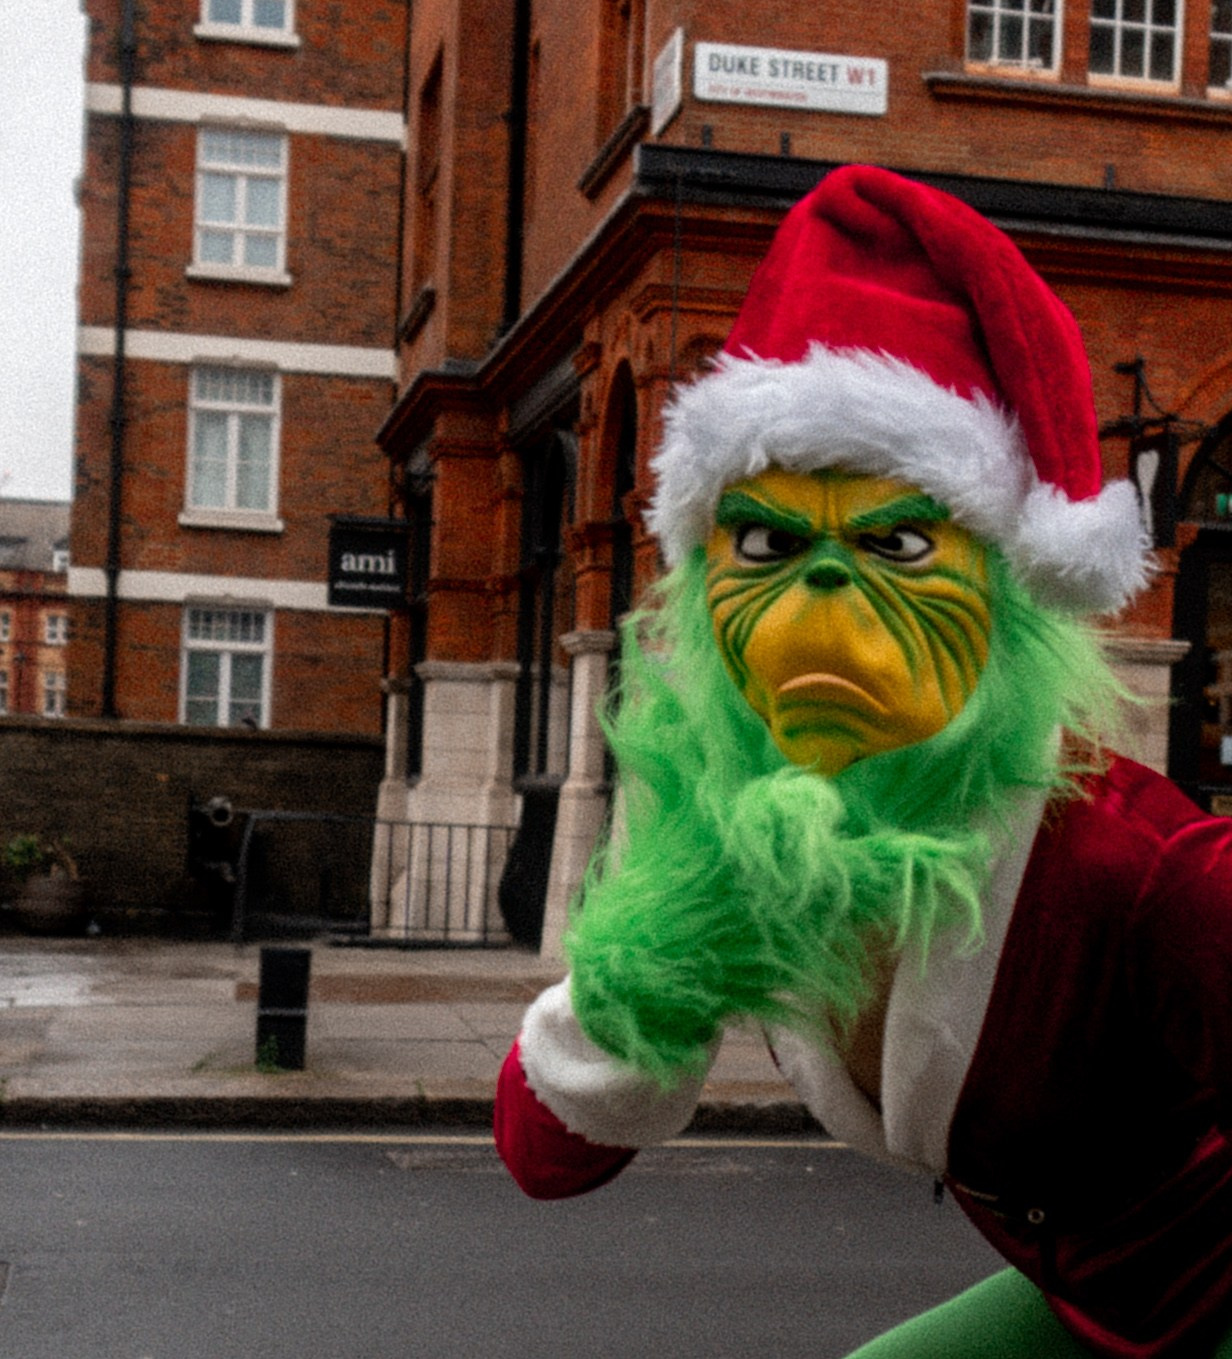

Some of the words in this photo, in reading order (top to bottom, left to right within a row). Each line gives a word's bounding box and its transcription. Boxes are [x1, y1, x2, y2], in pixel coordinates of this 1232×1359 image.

[708, 52, 760, 77] DUKE
[768, 57, 841, 83] STREET
[846, 64, 876, 87] W1
[341, 550, 396, 574] ami
